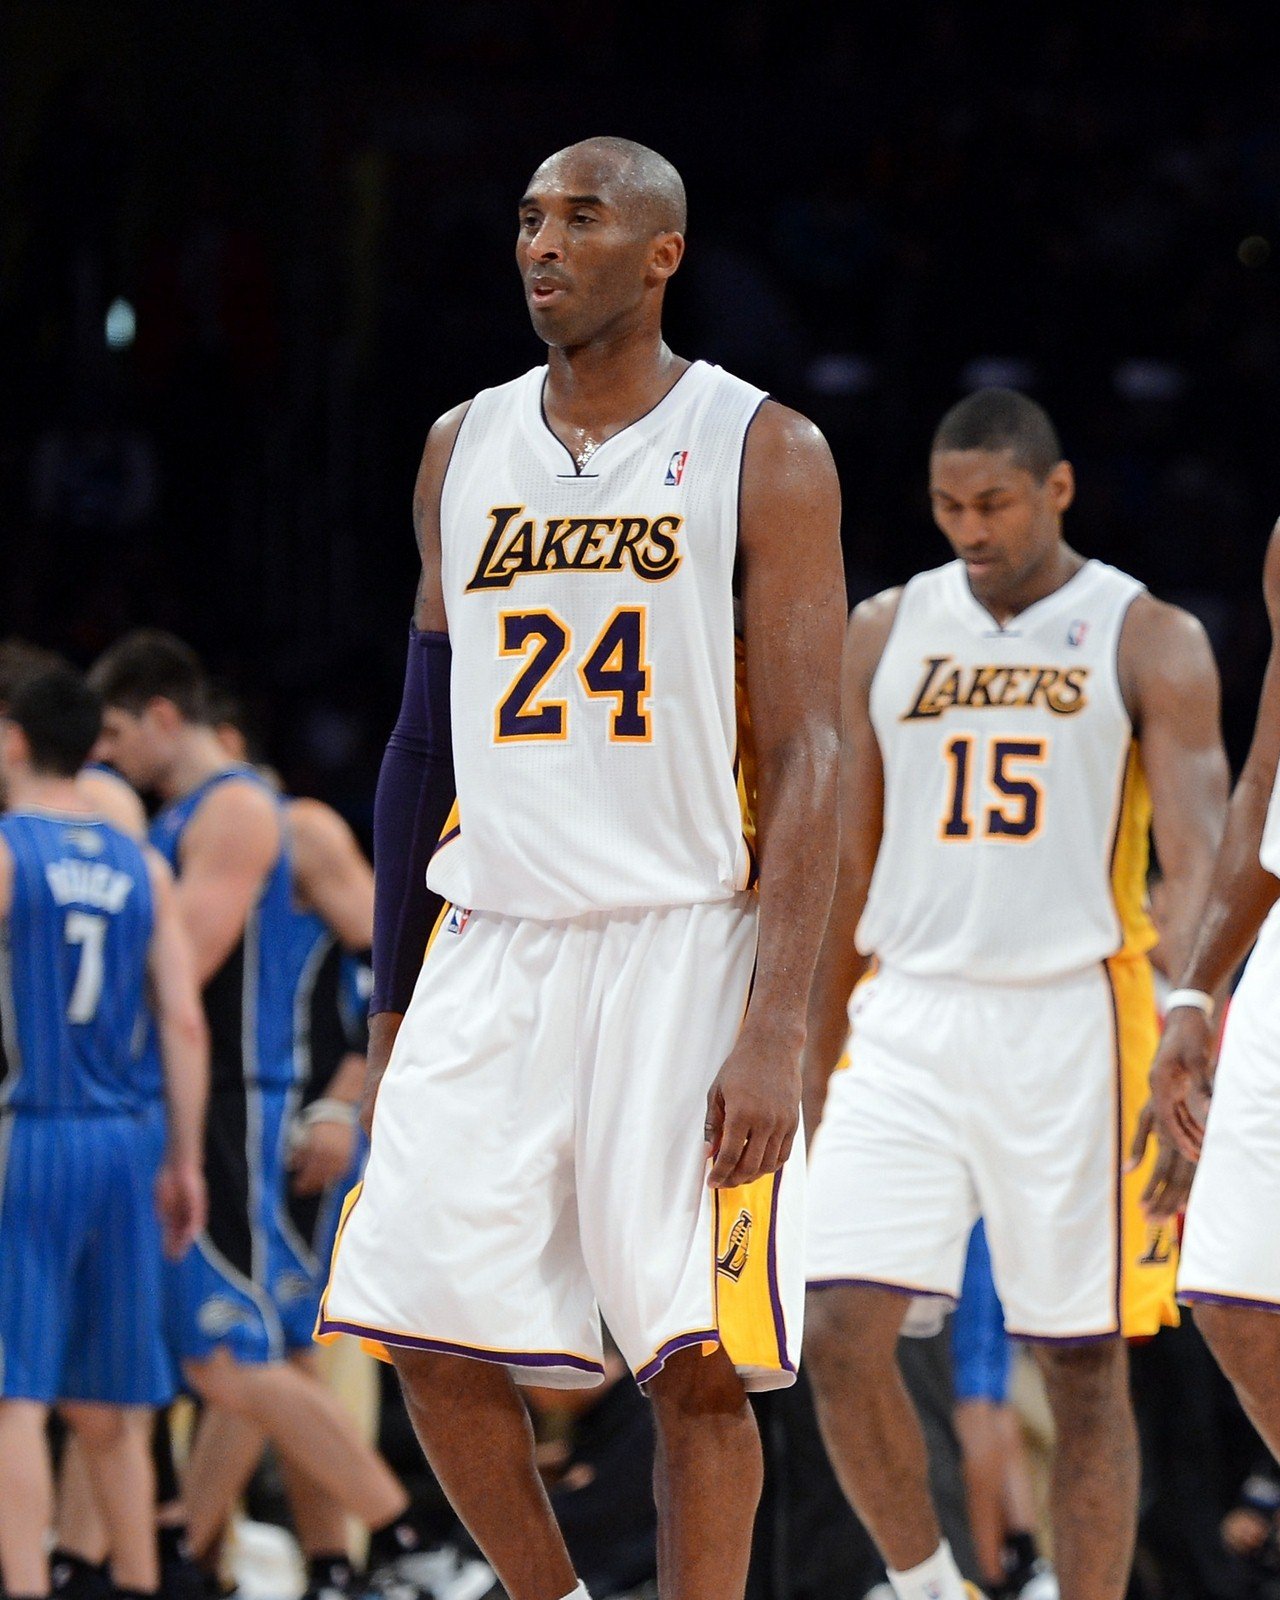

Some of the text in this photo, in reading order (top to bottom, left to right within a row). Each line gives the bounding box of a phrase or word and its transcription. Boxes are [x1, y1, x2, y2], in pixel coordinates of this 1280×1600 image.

[463, 503, 685, 594] LAKERS
[493, 605, 653, 743] 24
[899, 654, 1089, 722] LAKERS
[938, 733, 1047, 842] 15
[64, 909, 108, 1026] 7
